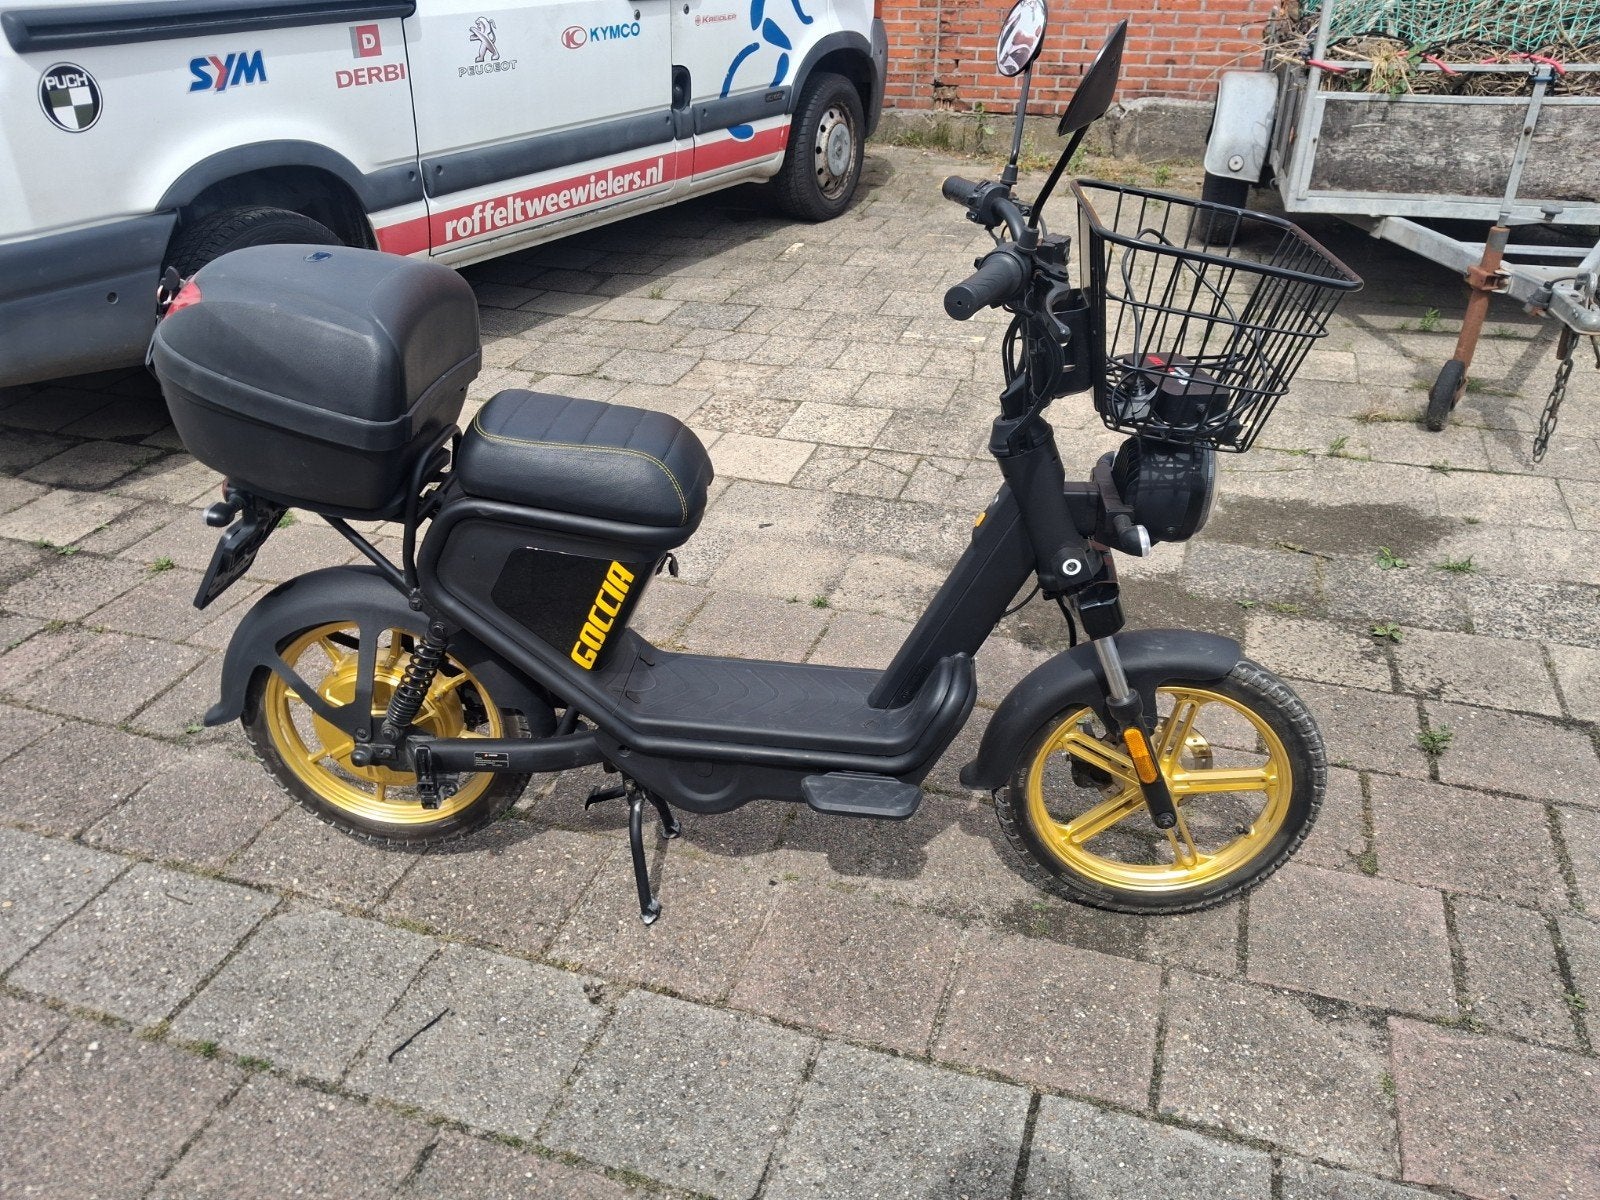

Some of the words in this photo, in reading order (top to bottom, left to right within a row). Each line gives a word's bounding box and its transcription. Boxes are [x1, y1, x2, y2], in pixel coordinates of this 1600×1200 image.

[589, 22, 641, 42] KYMCO
[44, 73, 89, 91] PUCH
[189, 51, 267, 91] SYM
[335, 62, 406, 89] DERBI
[458, 60, 518, 78] PEUGEOT
[445, 158, 664, 242] roffeltweewielers.nl
[570, 560, 635, 671] GOCCIA
